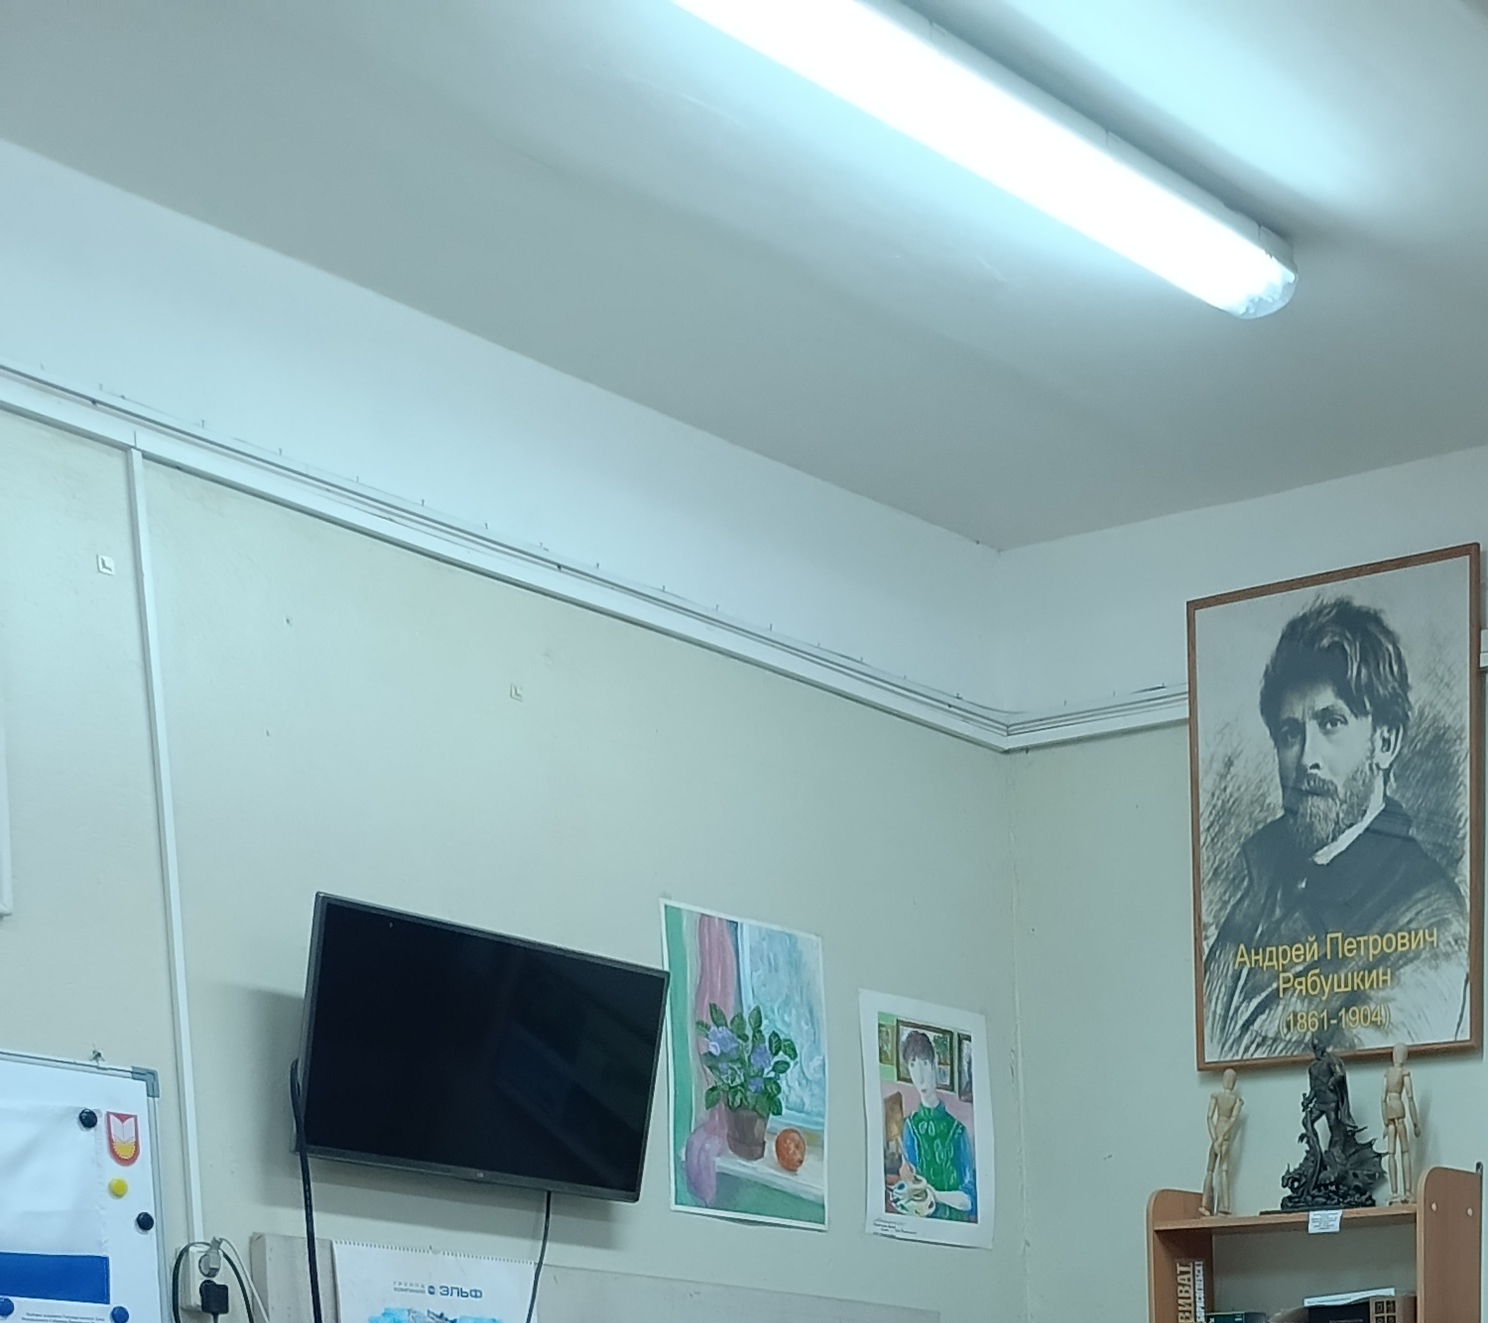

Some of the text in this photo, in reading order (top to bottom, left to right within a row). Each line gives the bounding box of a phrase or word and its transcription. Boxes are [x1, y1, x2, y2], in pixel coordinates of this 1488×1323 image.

[1234, 926, 1439, 971] Андрей Петрович
[1278, 966, 1392, 1001] Рябушкин
[439, 1285, 483, 1299] ЭЛЬФ
[1176, 1262, 1194, 1323] ВИВАТ
